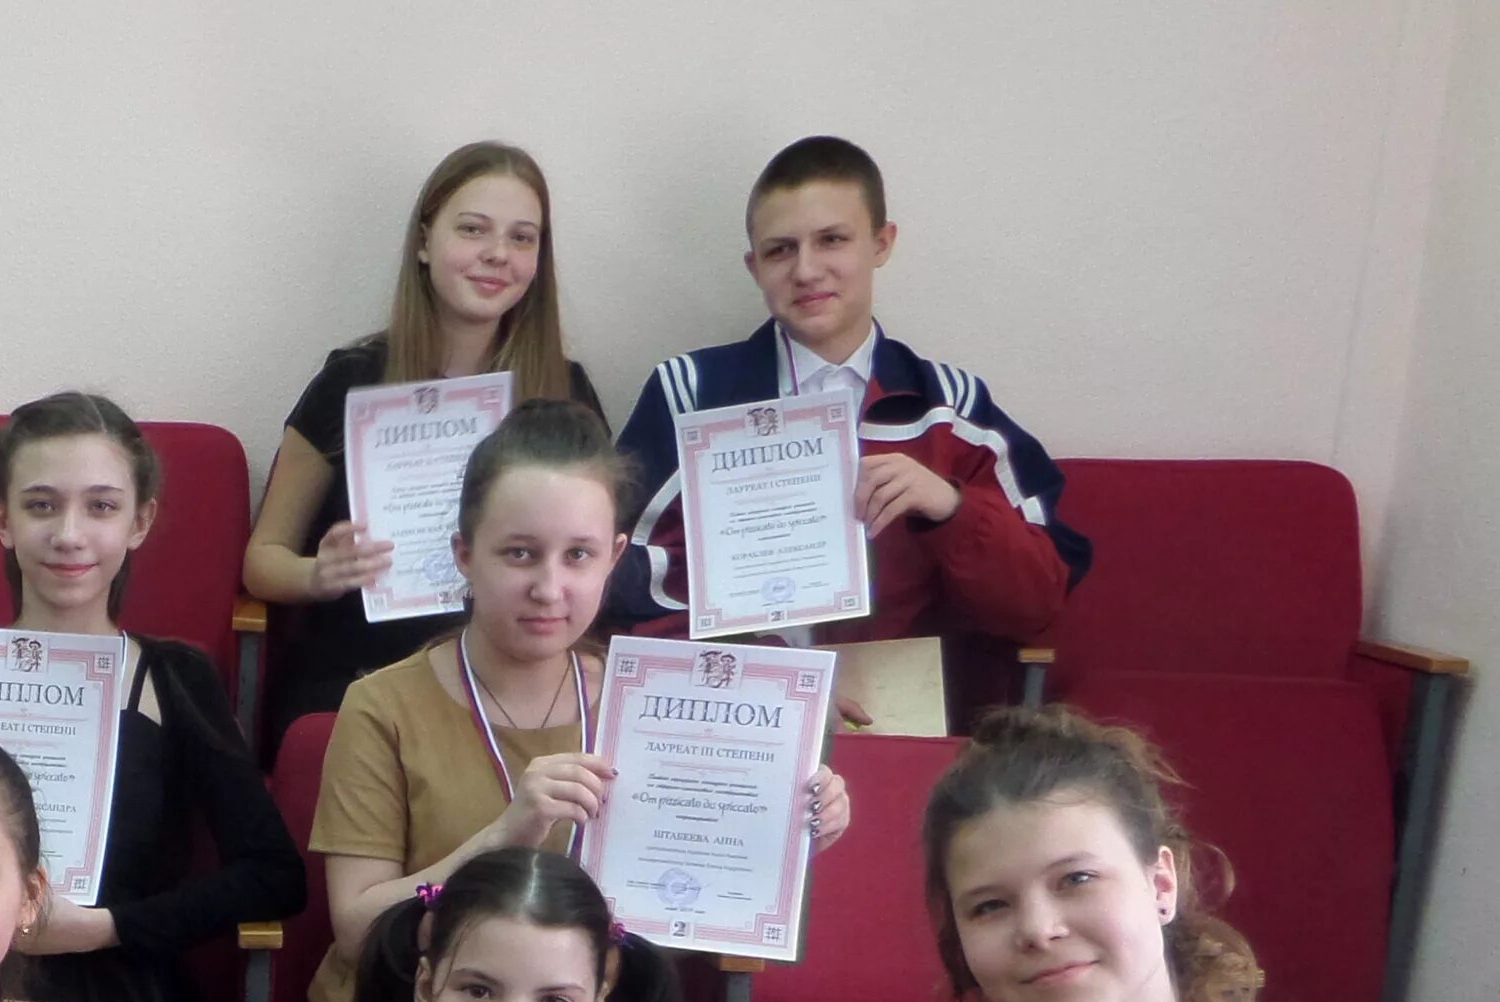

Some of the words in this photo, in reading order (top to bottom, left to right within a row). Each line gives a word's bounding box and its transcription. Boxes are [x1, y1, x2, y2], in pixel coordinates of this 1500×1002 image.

[712, 437, 823, 473] ДИПЛОМ
[639, 695, 783, 728] ДИПЛОМ
[28, 724, 76, 735] СТЕПЕНИ
[645, 742, 698, 756] ЛАУРЕАТ
[701, 747, 713, 758] III
[716, 748, 774, 763] СТЕПЕНИ
[673, 921, 686, 937] 2
